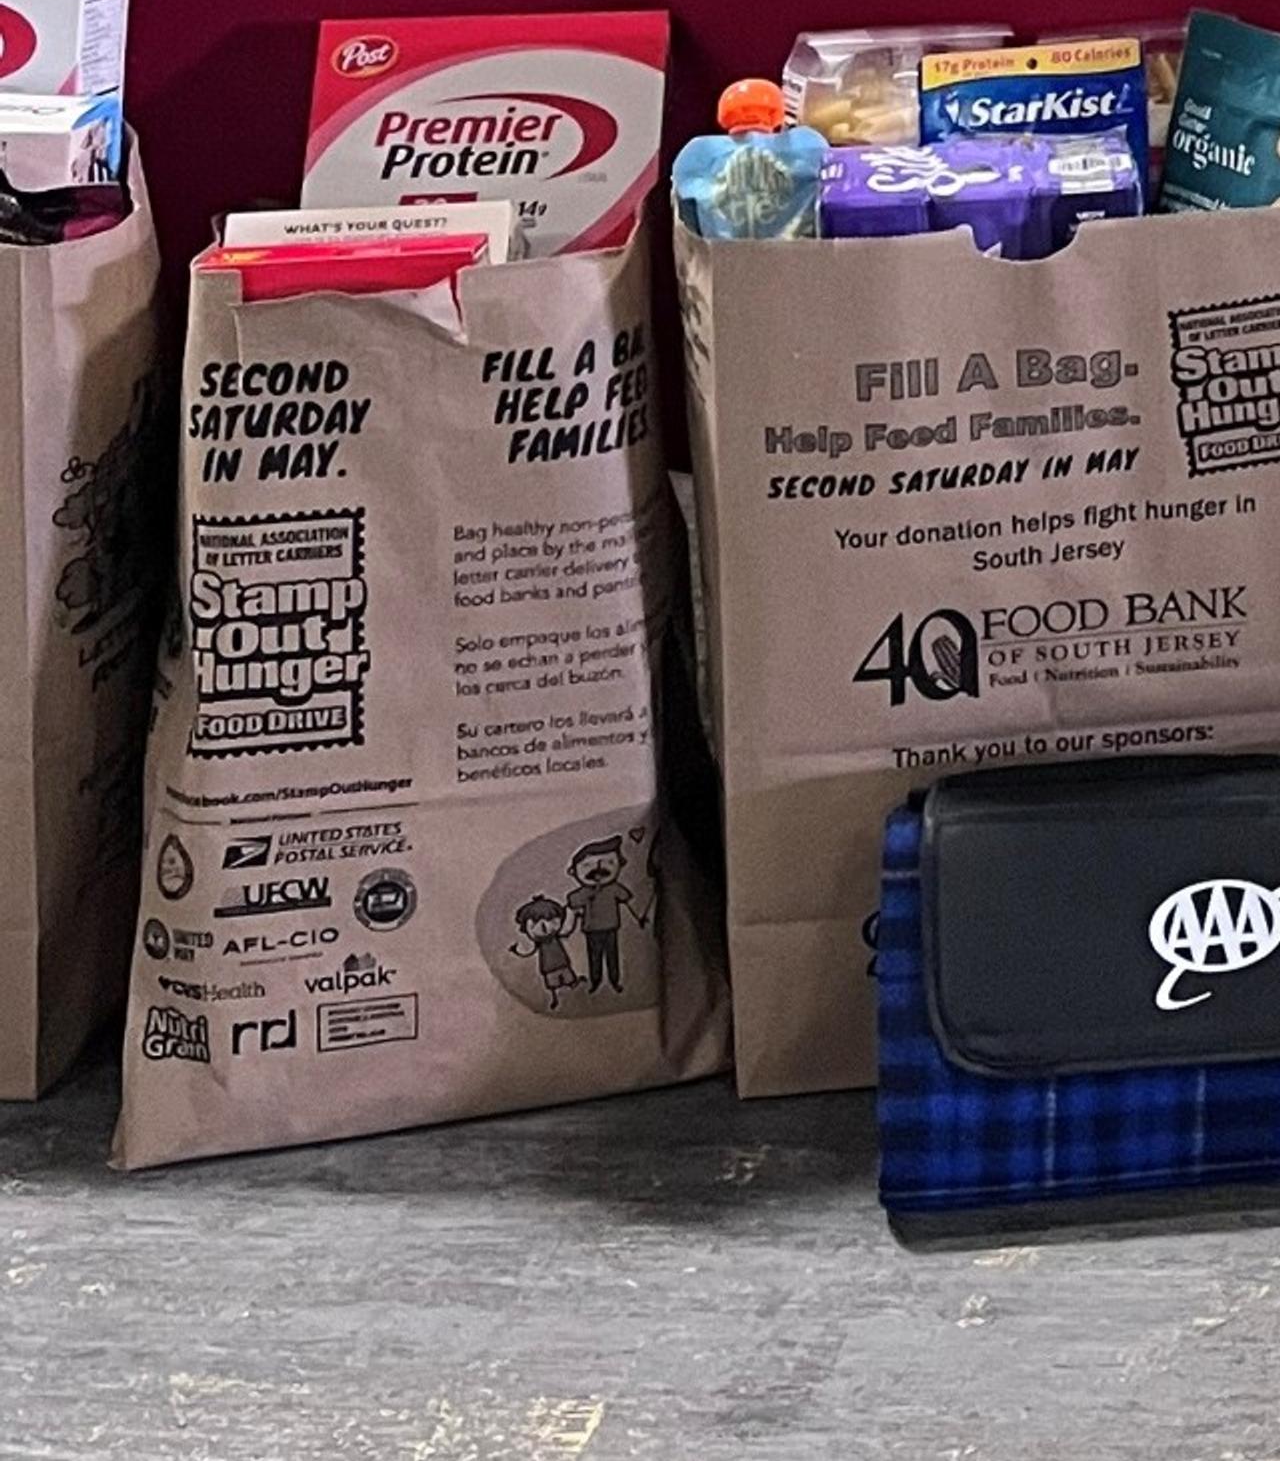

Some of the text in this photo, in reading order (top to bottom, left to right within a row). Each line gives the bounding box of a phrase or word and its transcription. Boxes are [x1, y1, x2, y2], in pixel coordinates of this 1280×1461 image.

[341, 40, 393, 71] Post
[962, 58, 1015, 72] Protein
[1074, 47, 1132, 62] Calories
[971, 88, 1116, 126] StarKist
[375, 107, 563, 147] Premier
[381, 142, 540, 179] Protein
[1173, 128, 1256, 176] organic
[284, 217, 448, 235] WHAT'S YOUR QUEST?
[518, 200, 547, 217] 14g
[201, 360, 350, 398] SECOND
[188, 398, 371, 440] SATURDAY
[203, 441, 347, 482] IN MAY.
[979, 585, 1247, 641] FOOD BANK
[987, 629, 1240, 667] OF SOUTH JERSEY
